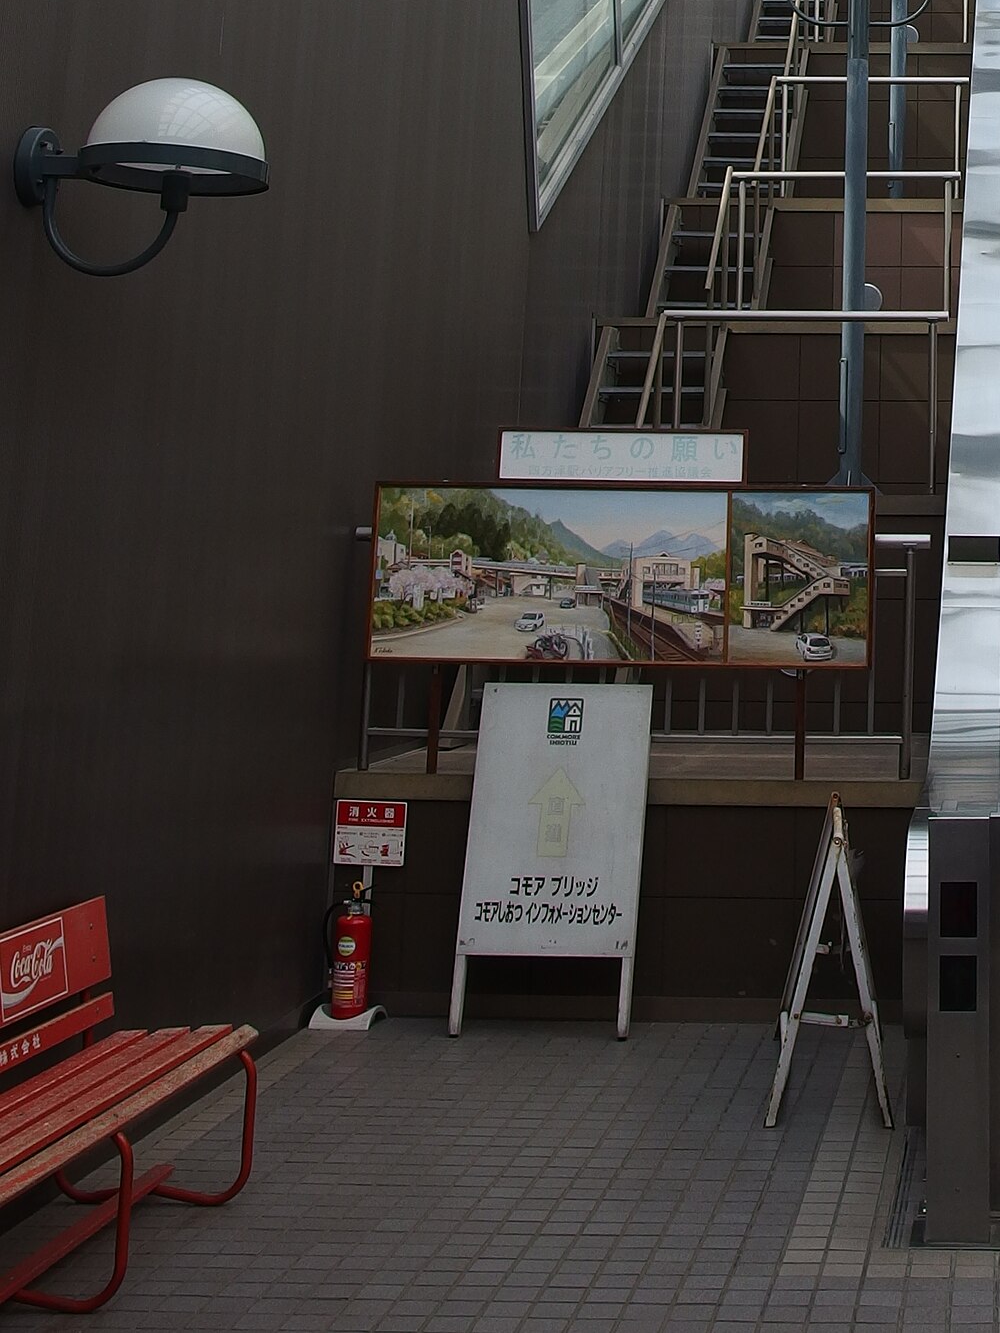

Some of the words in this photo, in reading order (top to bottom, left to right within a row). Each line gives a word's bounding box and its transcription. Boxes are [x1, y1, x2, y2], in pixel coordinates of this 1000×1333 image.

[511, 433, 738, 462] 私たちの願い
[349, 806, 394, 818] 消火器
[510, 876, 545, 897] コモア
[551, 876, 599, 897] ブリッジ
[525, 902, 622, 925] インフォメーションセンター
